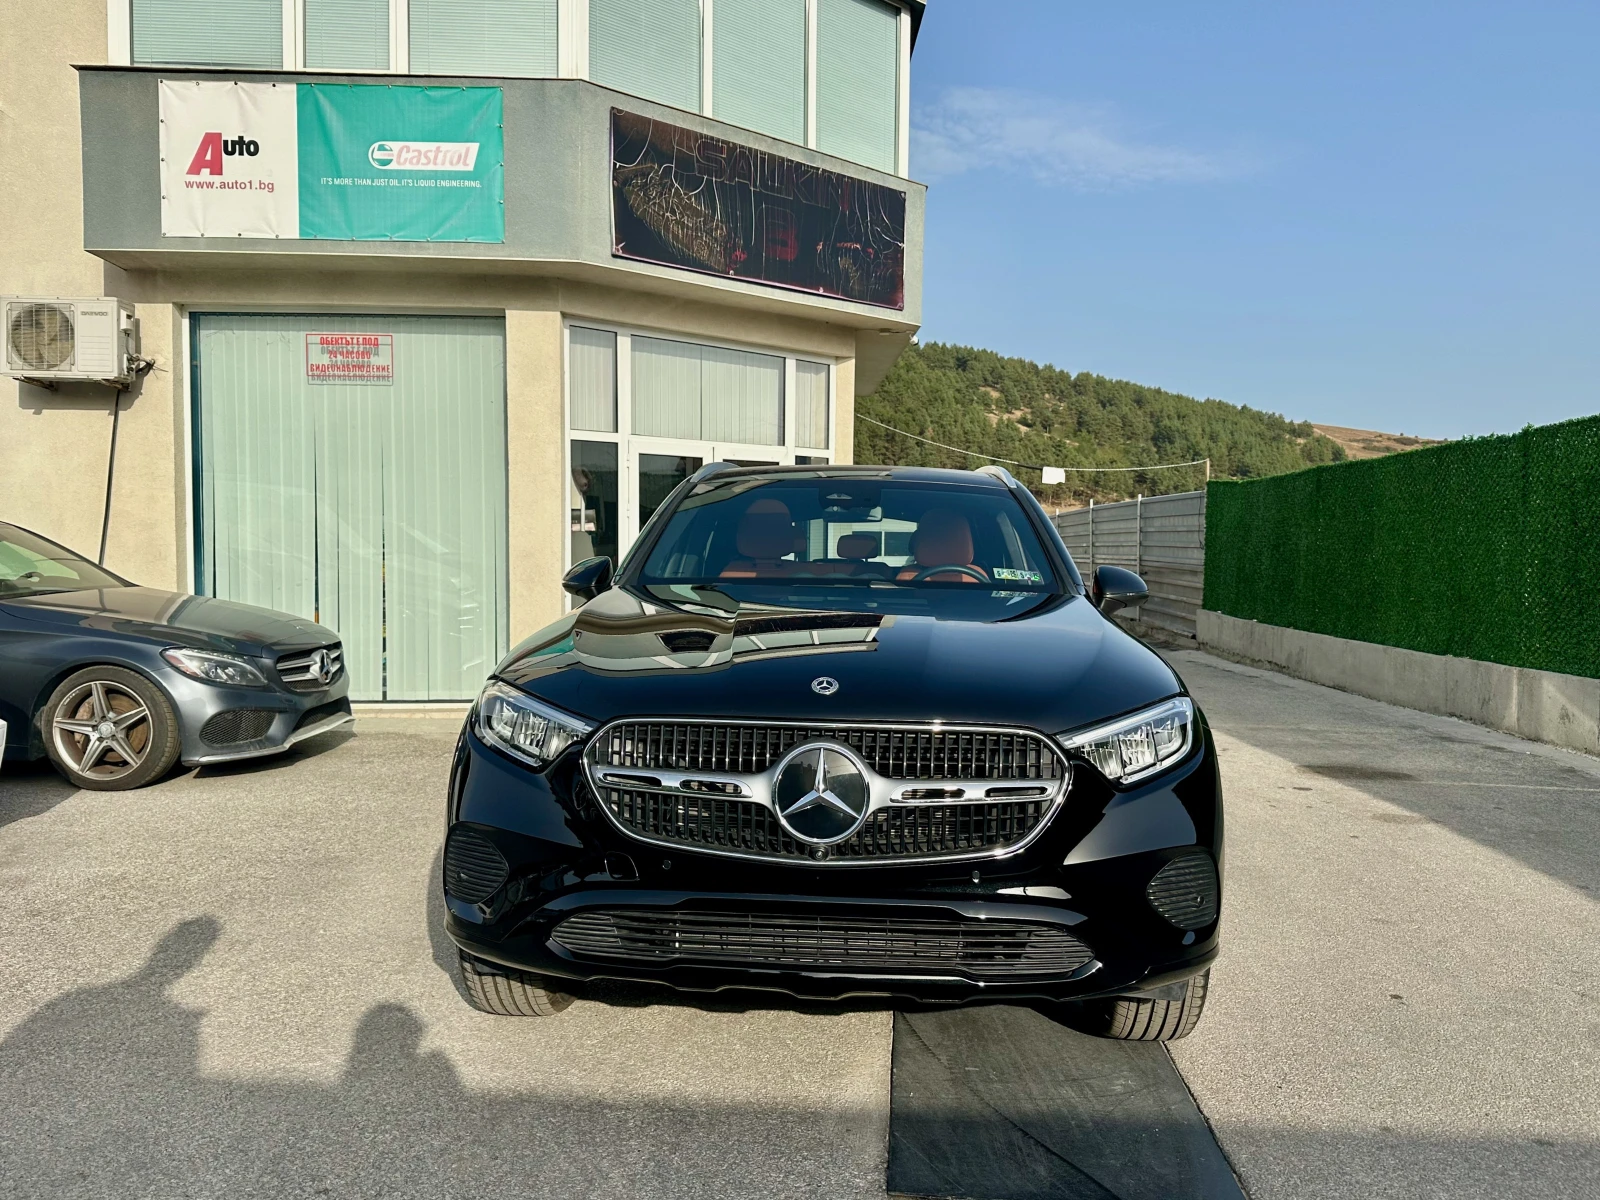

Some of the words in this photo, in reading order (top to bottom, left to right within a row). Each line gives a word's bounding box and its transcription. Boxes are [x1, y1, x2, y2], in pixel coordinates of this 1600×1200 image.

[186, 132, 260, 176] Auto
[395, 144, 471, 167] Castrol
[184, 179, 276, 193] www.auto1.bg
[320, 177, 333, 185] IT'S
[333, 177, 353, 186] MORE
[354, 178, 372, 186] THAN
[372, 178, 388, 186] JUST
[402, 179, 413, 187] IT'S
[414, 179, 436, 187] LIQUID
[436, 179, 482, 188] ENGINEERING.
[320, 337, 355, 346] ОБЕКТЪТ
[362, 338, 379, 347] ПОД
[329, 350, 337, 359] 24
[340, 351, 371, 359] ЧАСОВО
[310, 364, 390, 373] ВИДЕОНАБЛЮДЕНИЕ
